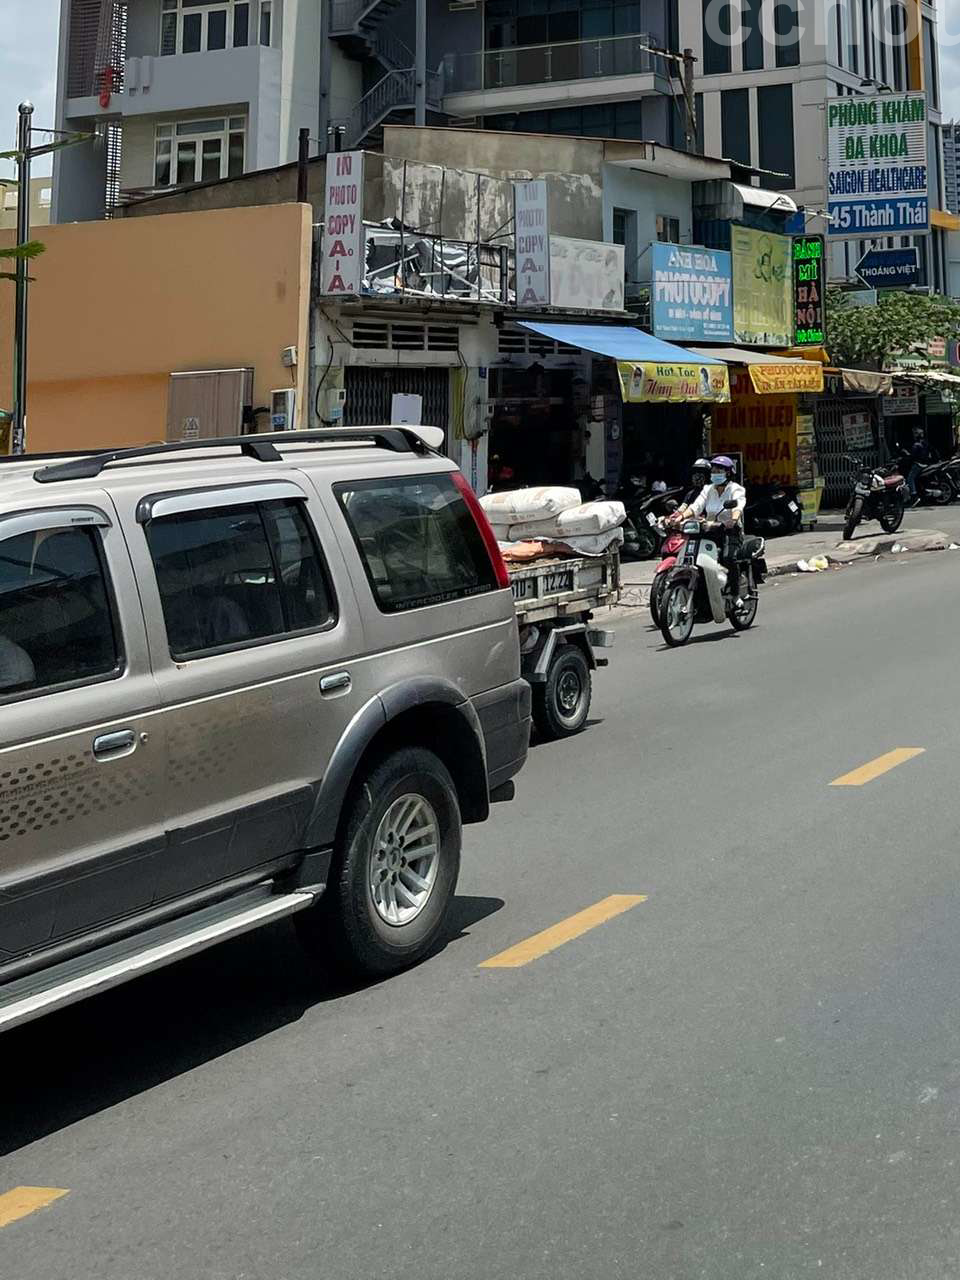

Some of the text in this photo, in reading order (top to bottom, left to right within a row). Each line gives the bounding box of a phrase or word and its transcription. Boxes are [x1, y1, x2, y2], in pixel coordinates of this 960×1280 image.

[829, 95, 925, 127] PHÒNG KHÁM
[845, 133, 909, 159] ĐA KHOA
[336, 156, 352, 176] IN
[829, 165, 927, 195] SAIGON HEALTHCARE
[329, 184, 357, 205] PHOTO
[328, 214, 356, 235] COPY
[829, 200, 927, 229] 45 Thành Thái
[518, 234, 544, 254] COPY
[656, 270, 731, 307] PHOTOCOPY
